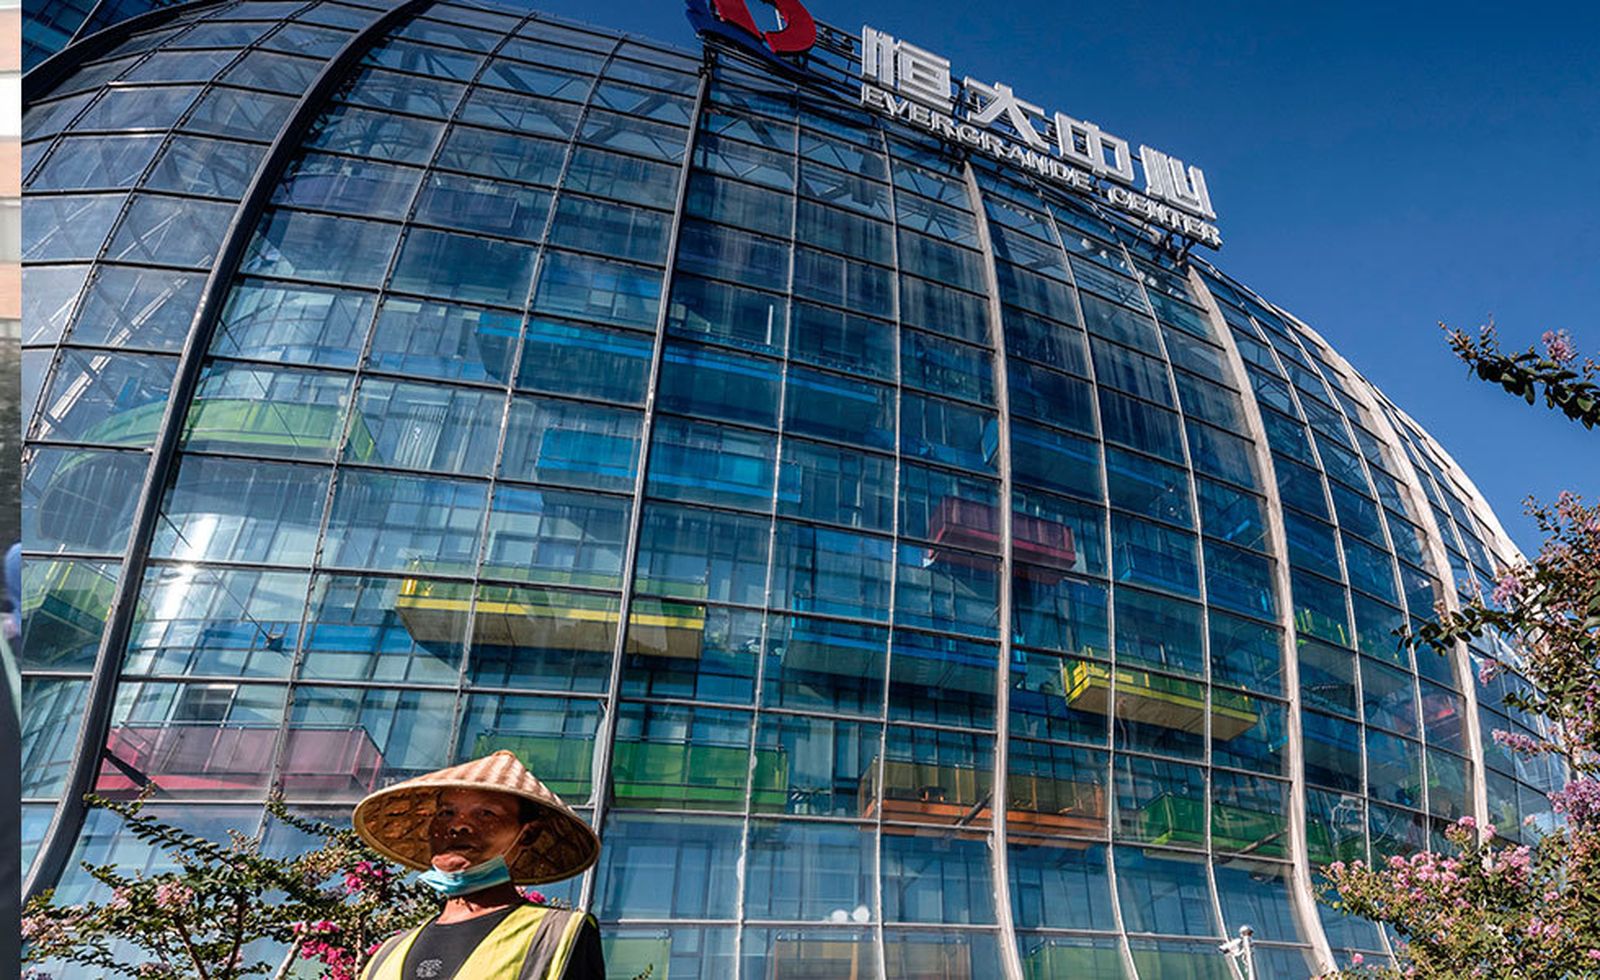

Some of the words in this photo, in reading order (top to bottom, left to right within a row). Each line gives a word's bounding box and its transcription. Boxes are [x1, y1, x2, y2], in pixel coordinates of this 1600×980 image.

[861, 25, 1217, 219] 恒大中心
[862, 85, 1092, 190] EVERGRANDE
[1108, 186, 1222, 246] CENTER
